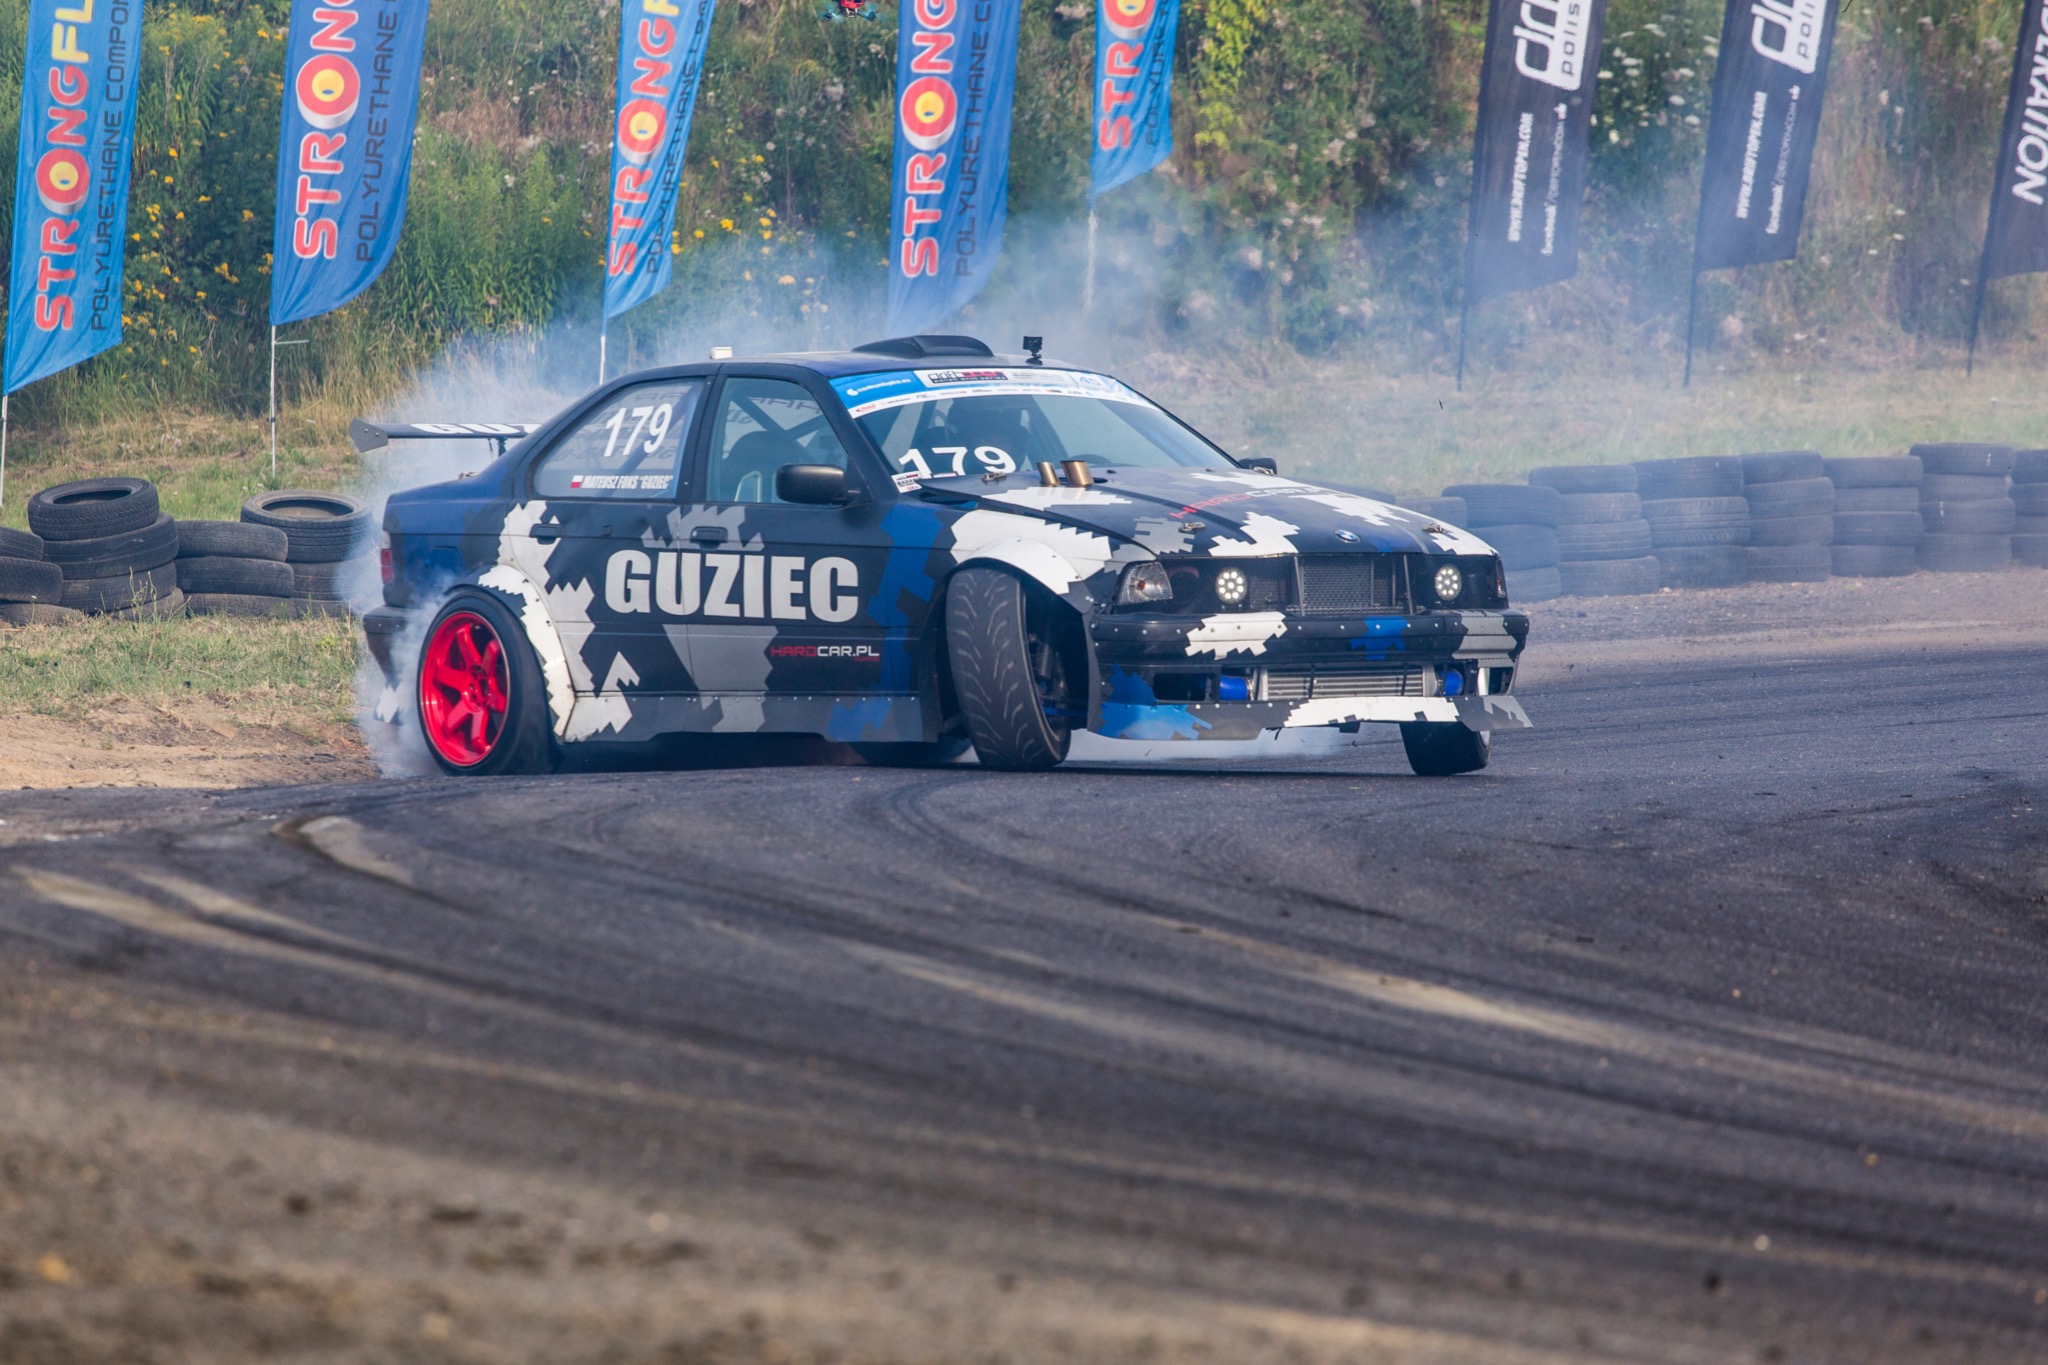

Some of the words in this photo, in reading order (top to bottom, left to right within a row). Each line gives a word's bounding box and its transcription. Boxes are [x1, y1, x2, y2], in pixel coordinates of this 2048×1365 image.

[105, 0, 129, 101] COMPO
[293, 0, 360, 260] STRON
[356, 10, 398, 262] POLYURETHANE
[956, 31, 989, 276] POLYURETHANE
[974, 0, 992, 22] C
[91, 110, 122, 331] POLYURETHANE
[604, 403, 673, 457] 179
[898, 446, 1016, 479] 179
[605, 549, 859, 623] GUZIEC
[770, 645, 880, 657] HARDCAR.PL
